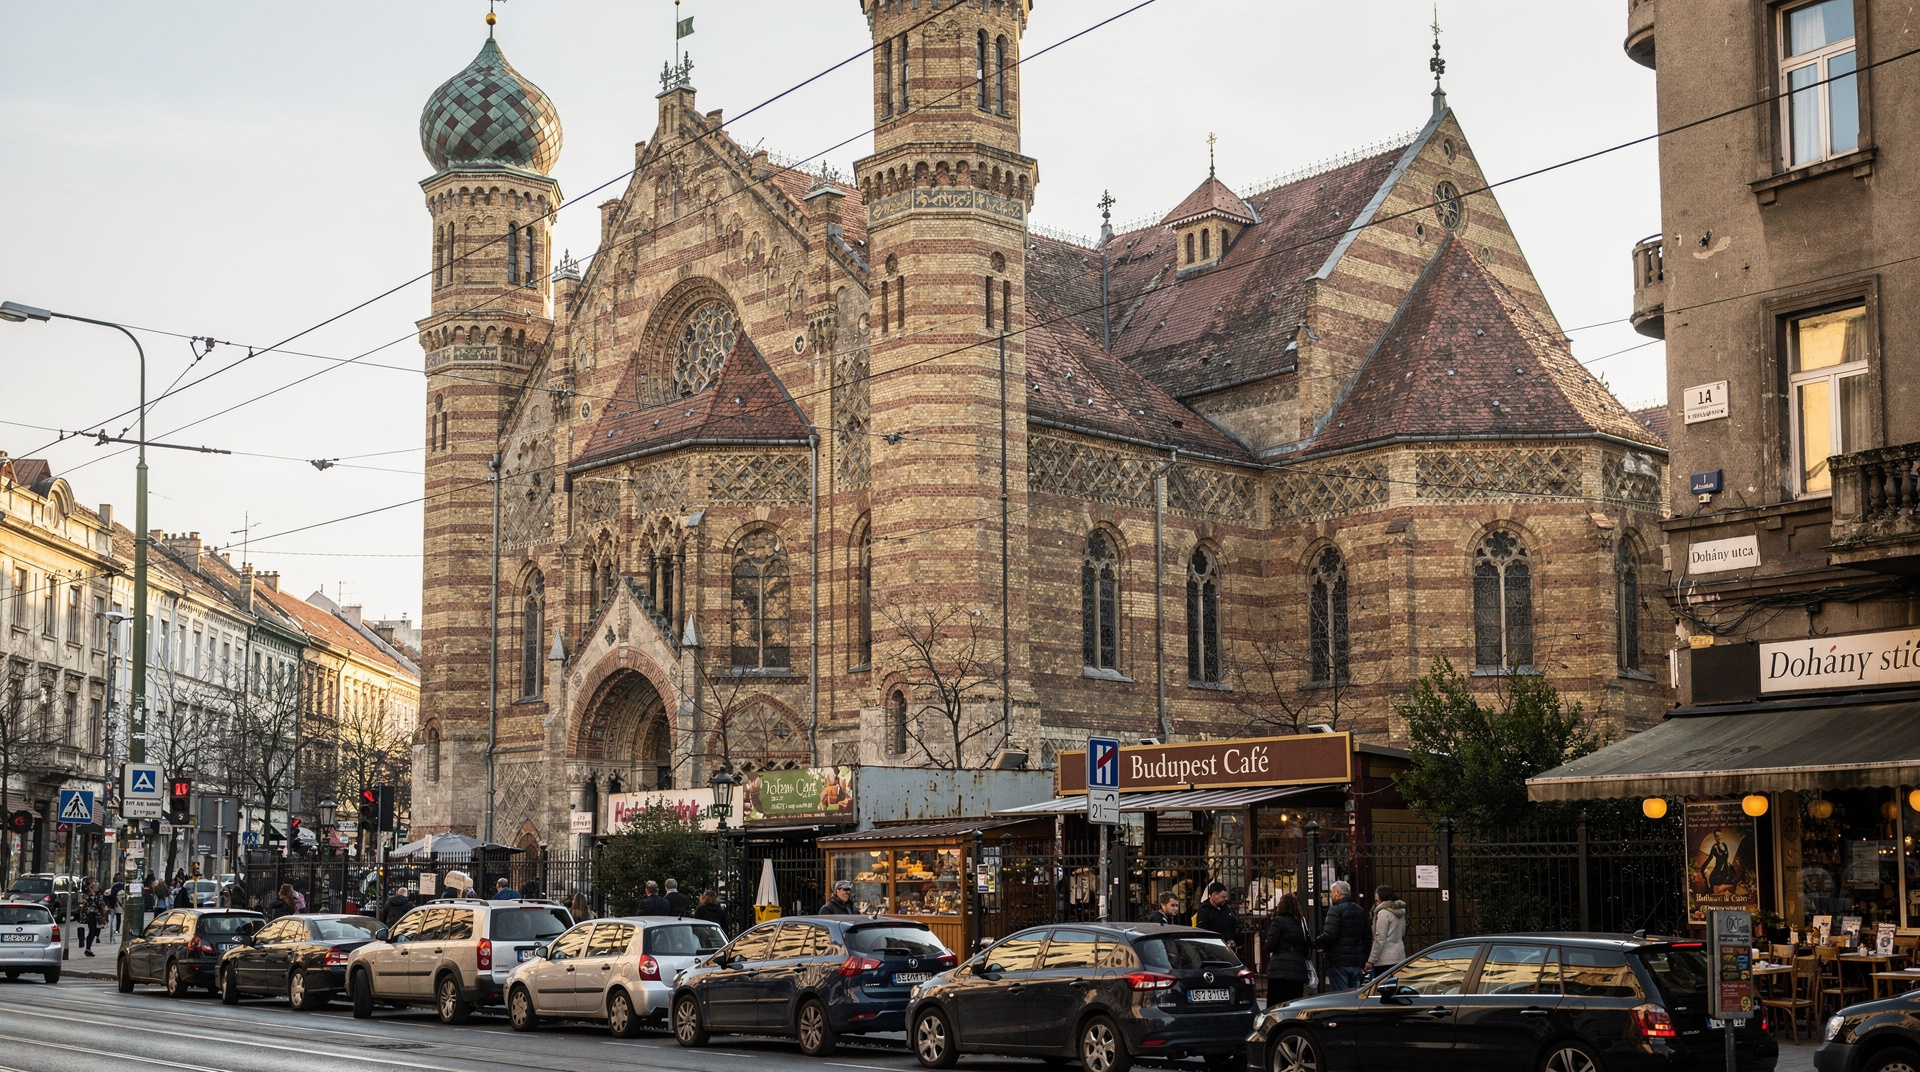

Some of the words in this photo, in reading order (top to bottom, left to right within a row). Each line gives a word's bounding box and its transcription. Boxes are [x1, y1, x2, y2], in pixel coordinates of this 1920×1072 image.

[1692, 548, 1730, 564] Dohány
[1731, 546, 1754, 558] utca
[1768, 644, 1874, 681] Dohány
[1130, 752, 1218, 785] Budupest
[1223, 745, 1269, 775] Café
